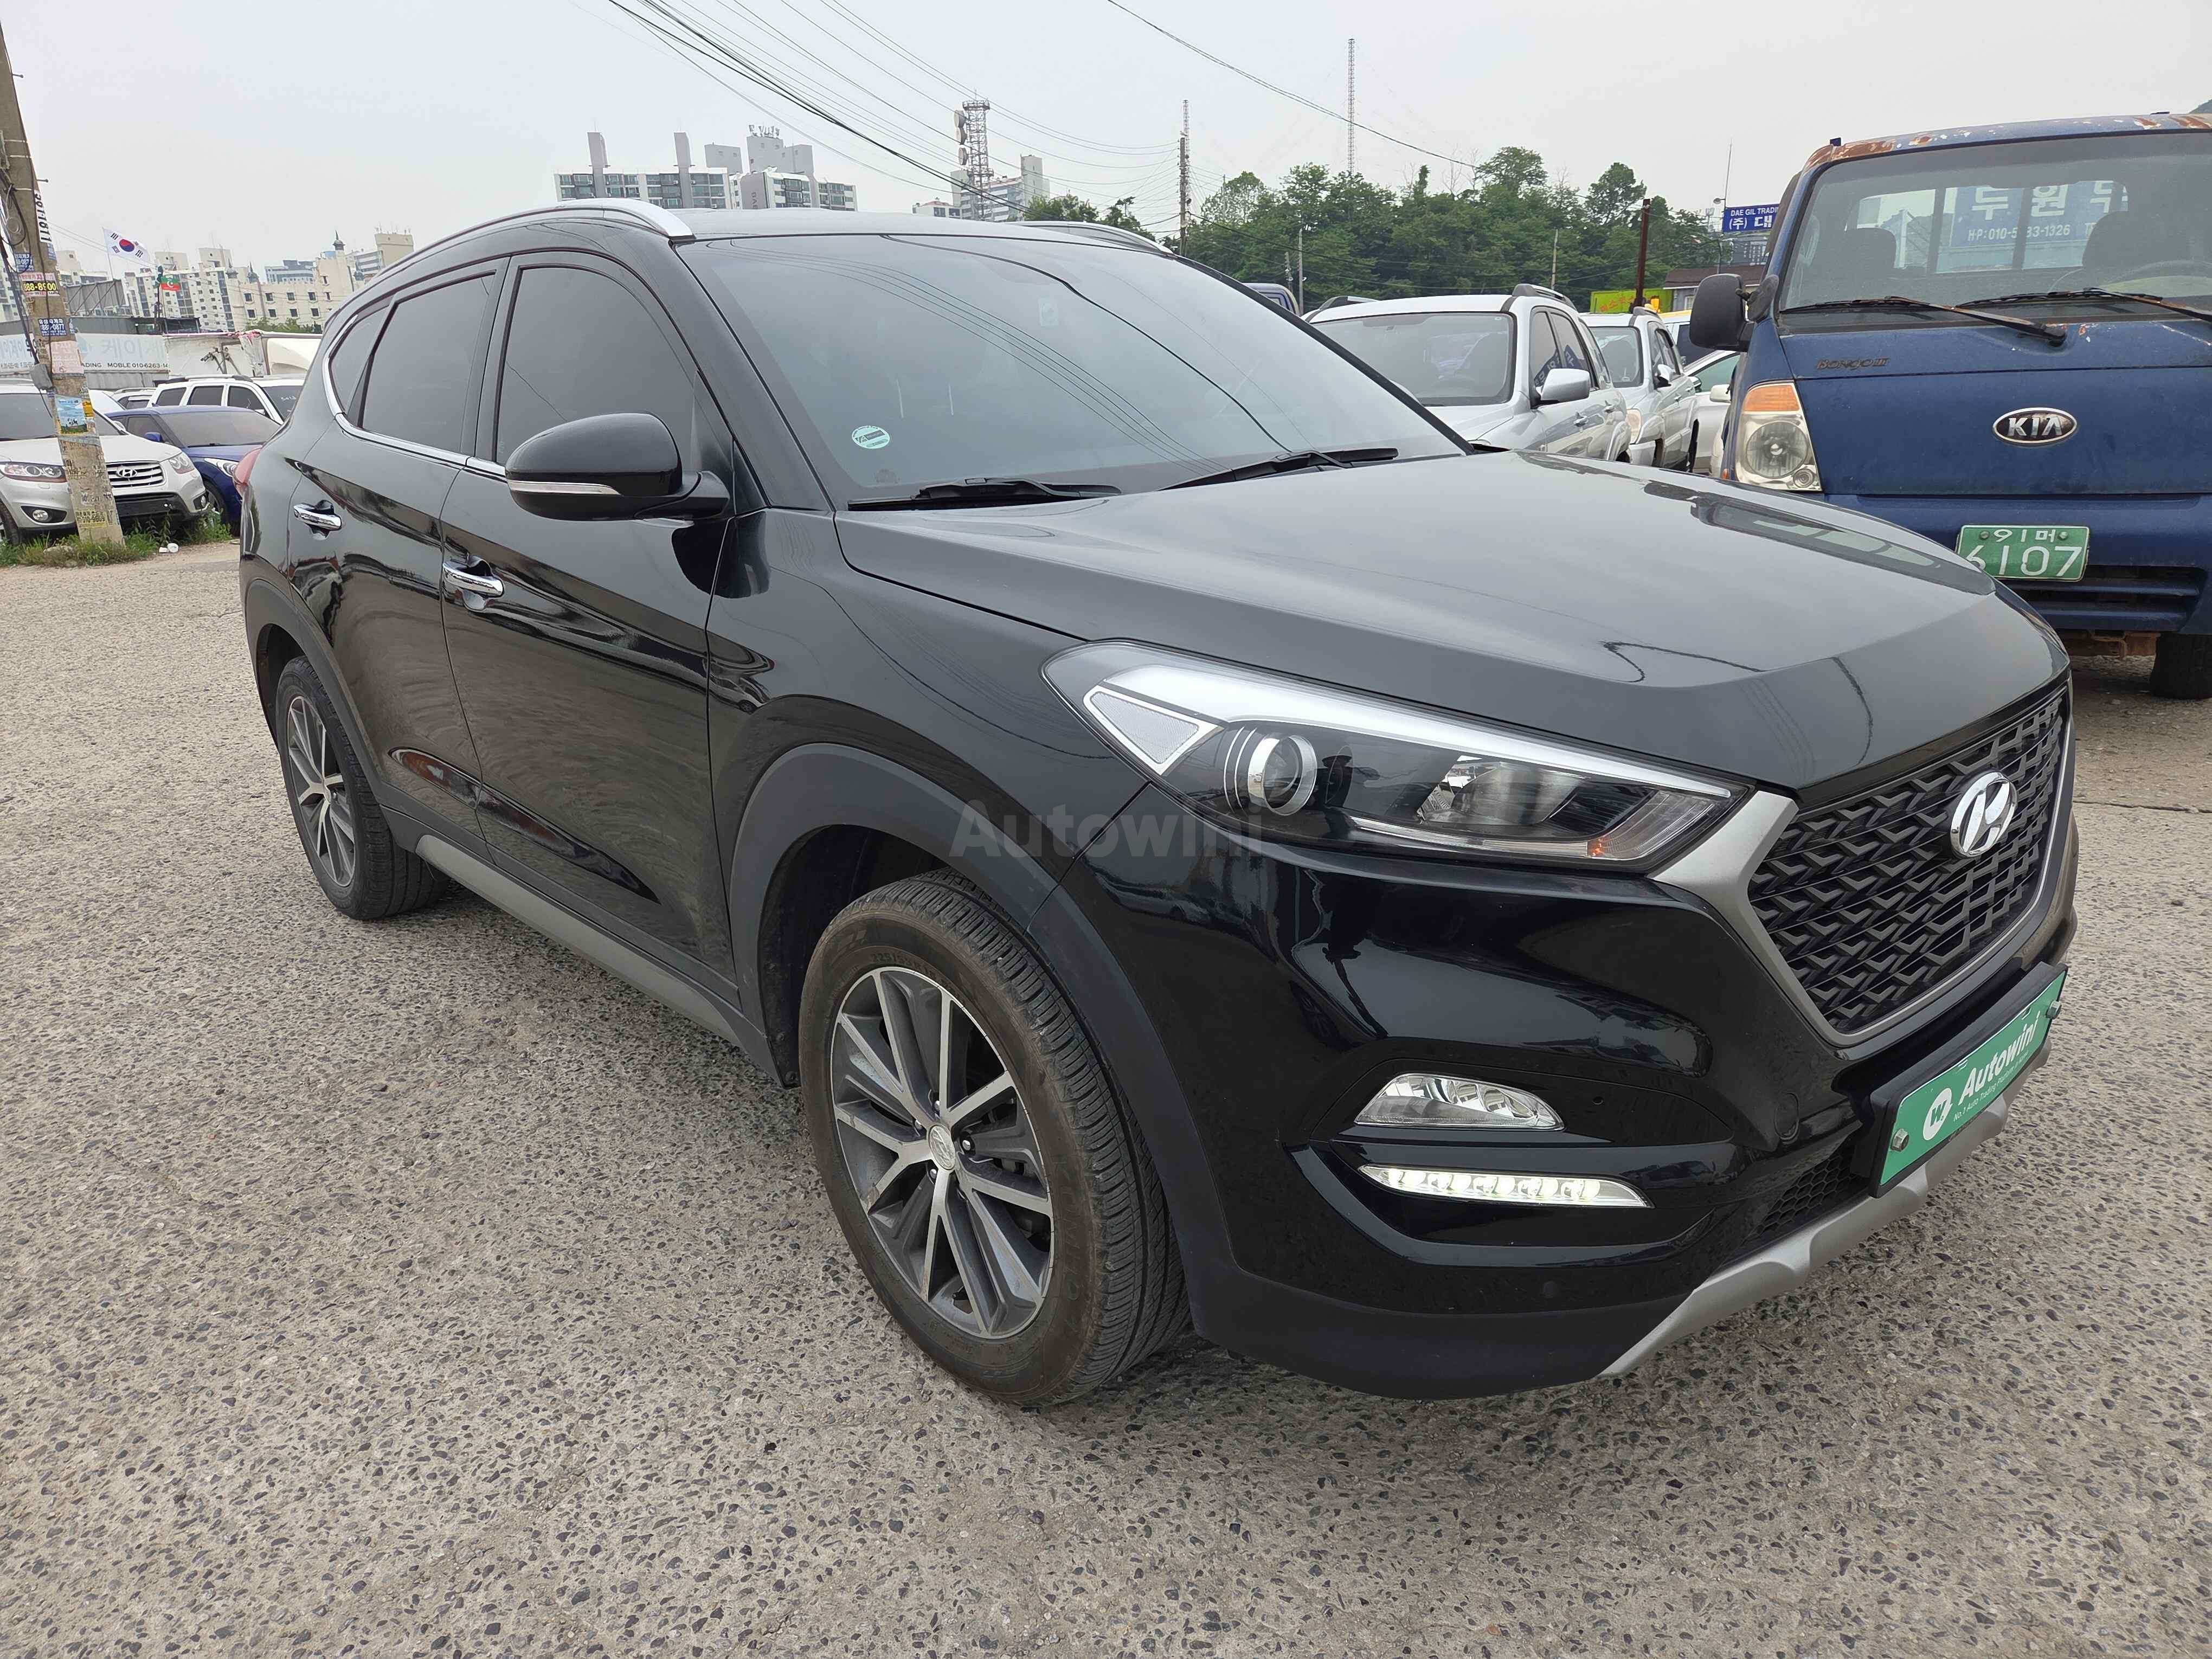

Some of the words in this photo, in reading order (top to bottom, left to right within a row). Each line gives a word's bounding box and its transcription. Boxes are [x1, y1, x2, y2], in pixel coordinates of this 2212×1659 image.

[1729, 217, 1747, 230] (주)
[1754, 215, 1772, 228] 대
[2008, 416, 2063, 436] KIA
[1966, 545, 2082, 577] 6107
[1958, 1010, 2041, 1106] Autowini
